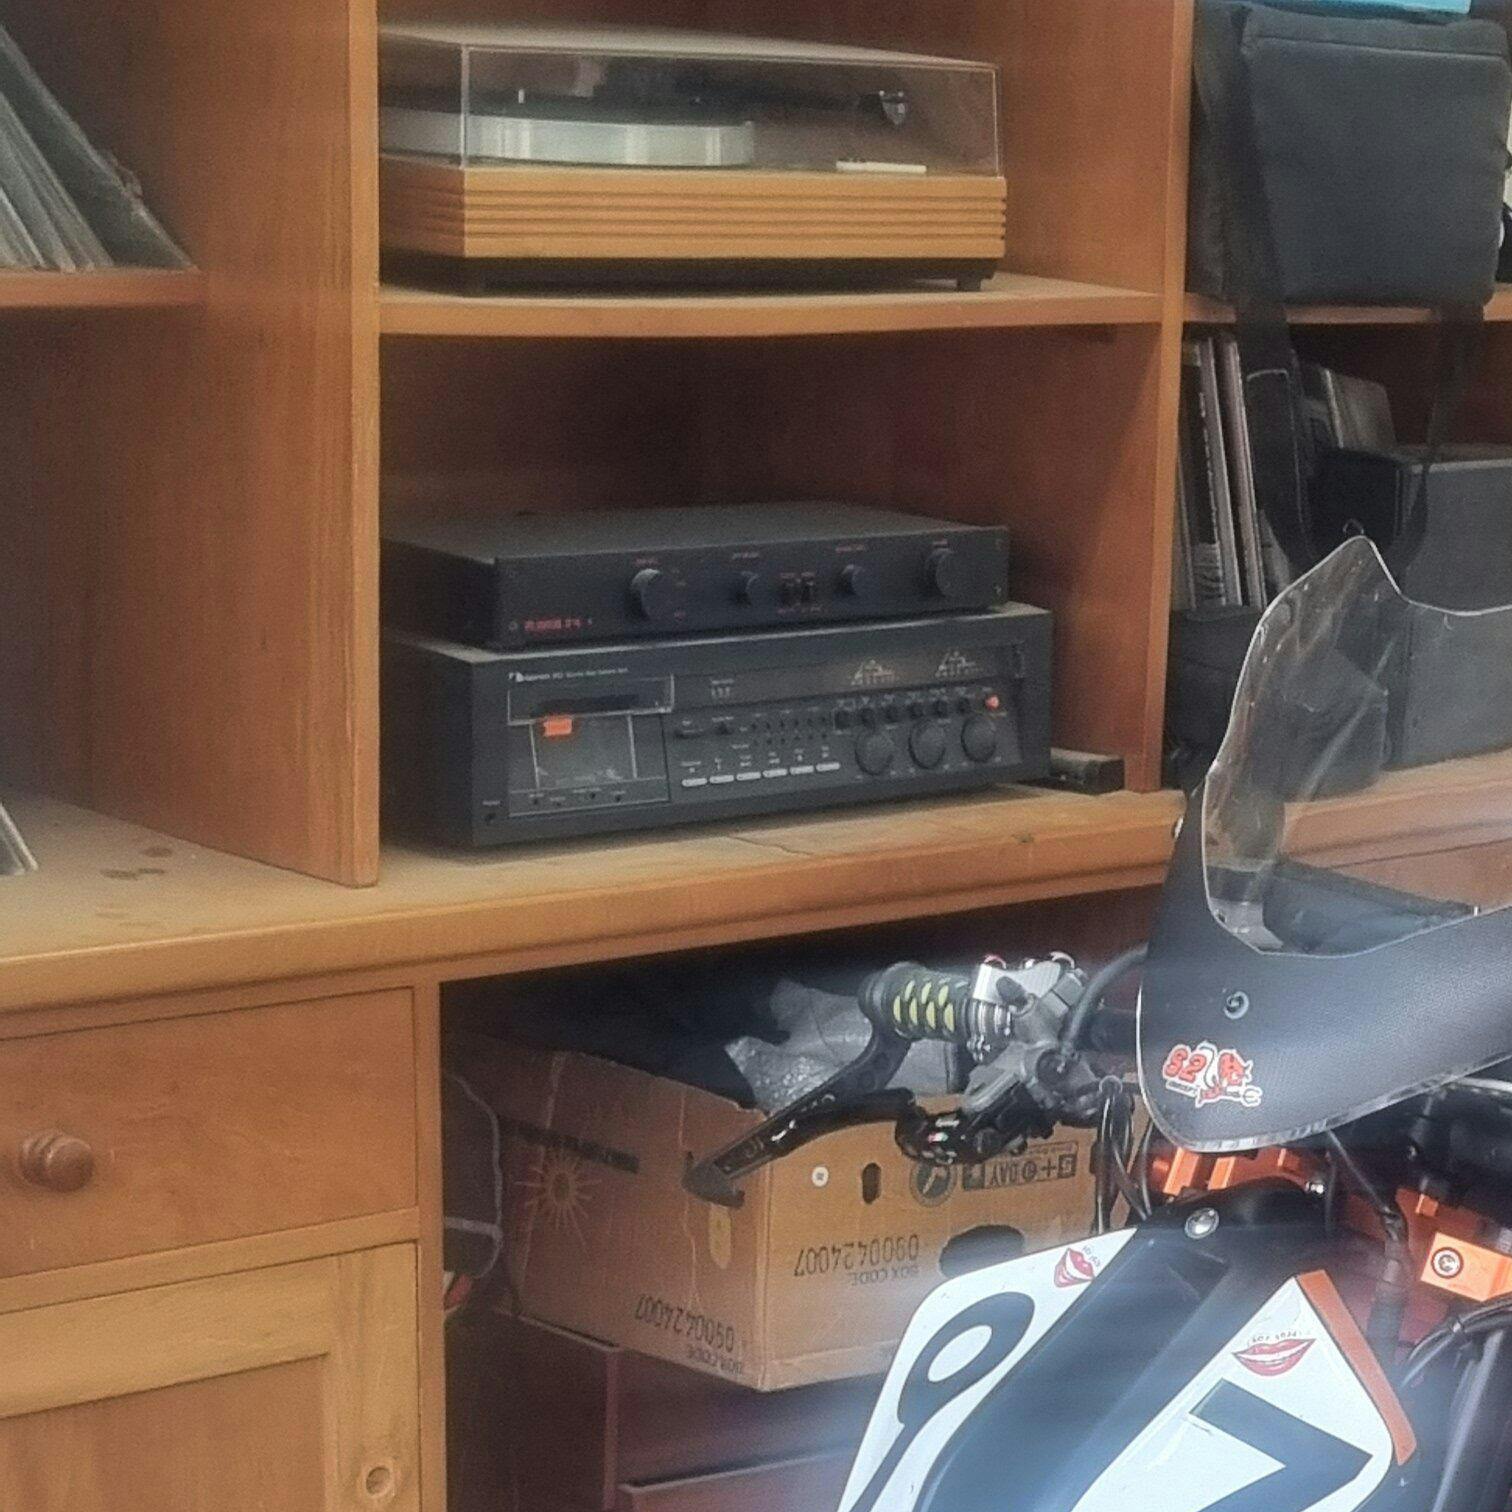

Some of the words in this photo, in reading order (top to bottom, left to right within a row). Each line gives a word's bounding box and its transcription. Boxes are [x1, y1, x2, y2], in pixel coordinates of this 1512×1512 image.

[794, 1234, 921, 1277] 0900424007
[850, 1267, 889, 1288] CODE
[634, 1294, 736, 1353] 0900424007
